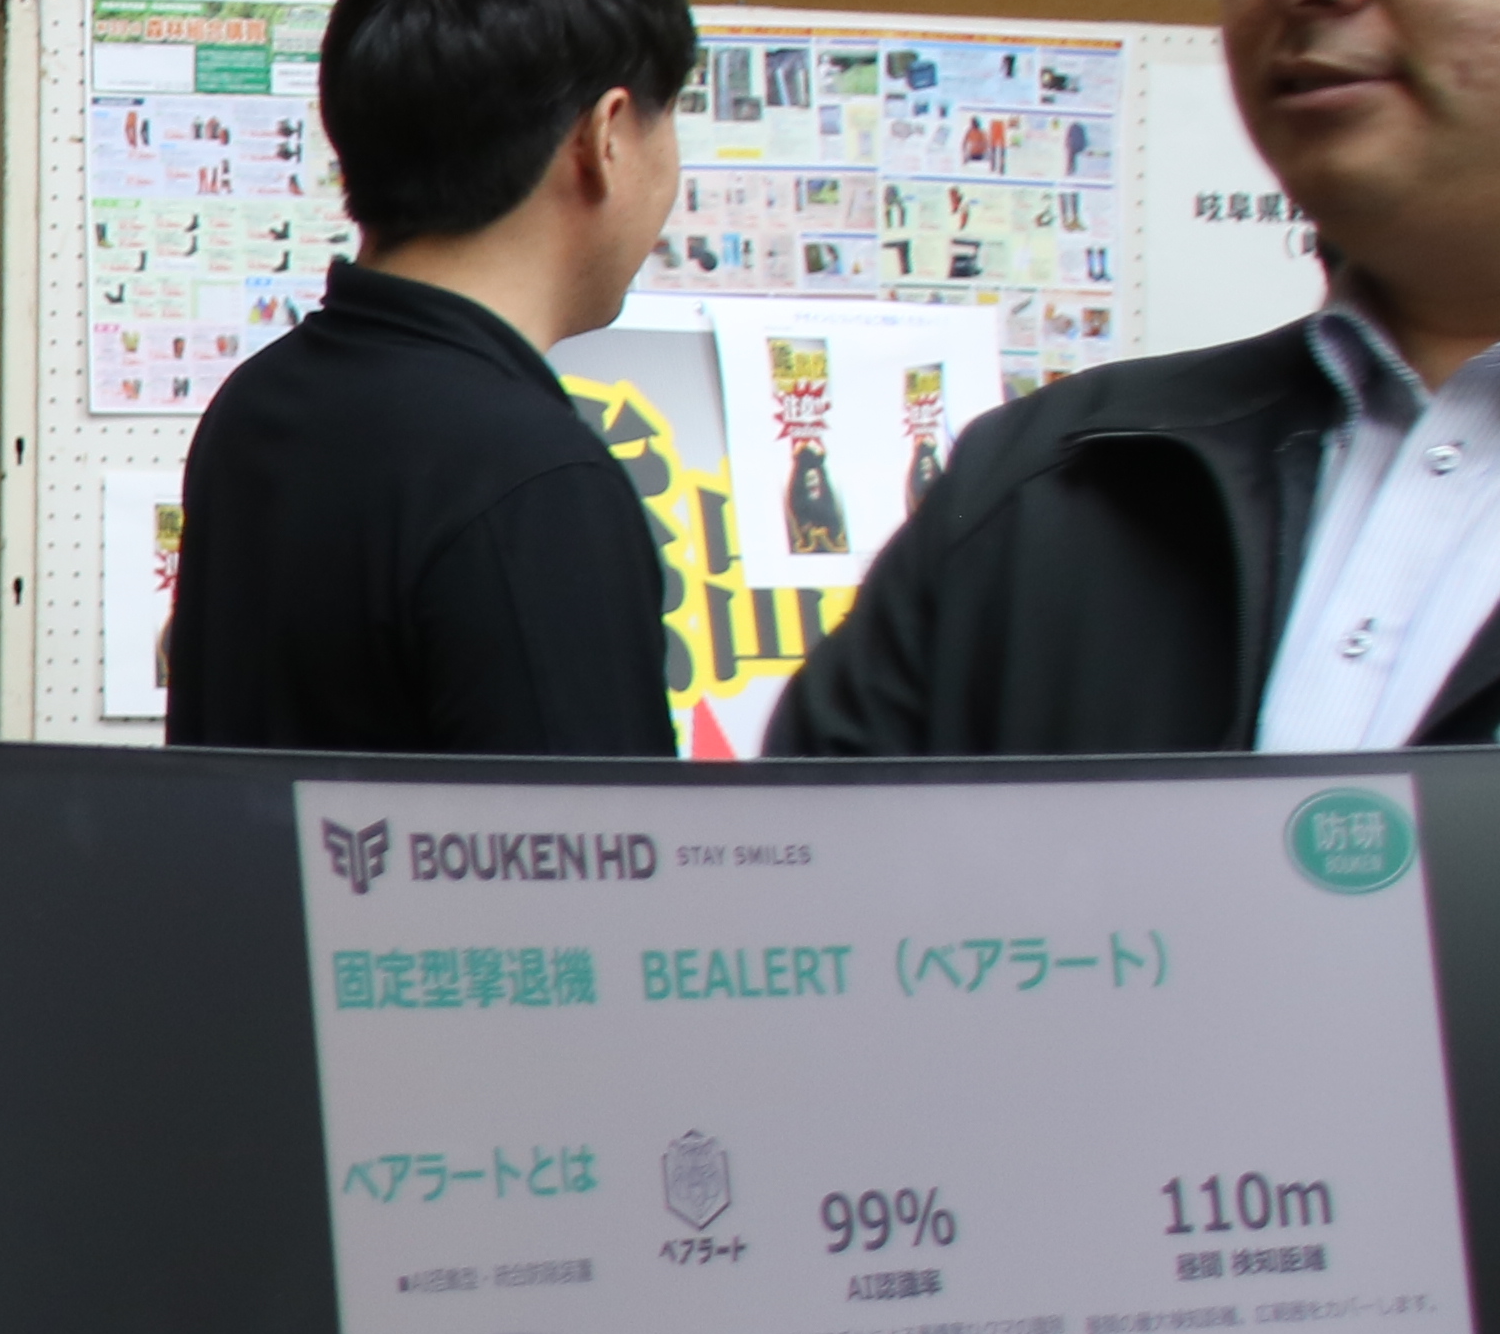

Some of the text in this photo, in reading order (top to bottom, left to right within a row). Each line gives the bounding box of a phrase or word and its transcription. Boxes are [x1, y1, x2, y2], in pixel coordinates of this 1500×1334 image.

[408, 831, 813, 882] BOUKEN HD STAY SMILES
[1312, 809, 1387, 852] 防研
[331, 929, 1169, 1010] 固定型撃退機 BEALERT (ベアラート)
[342, 1144, 600, 1203] ベアラートとは
[819, 1170, 1336, 1255] 99% 110m
